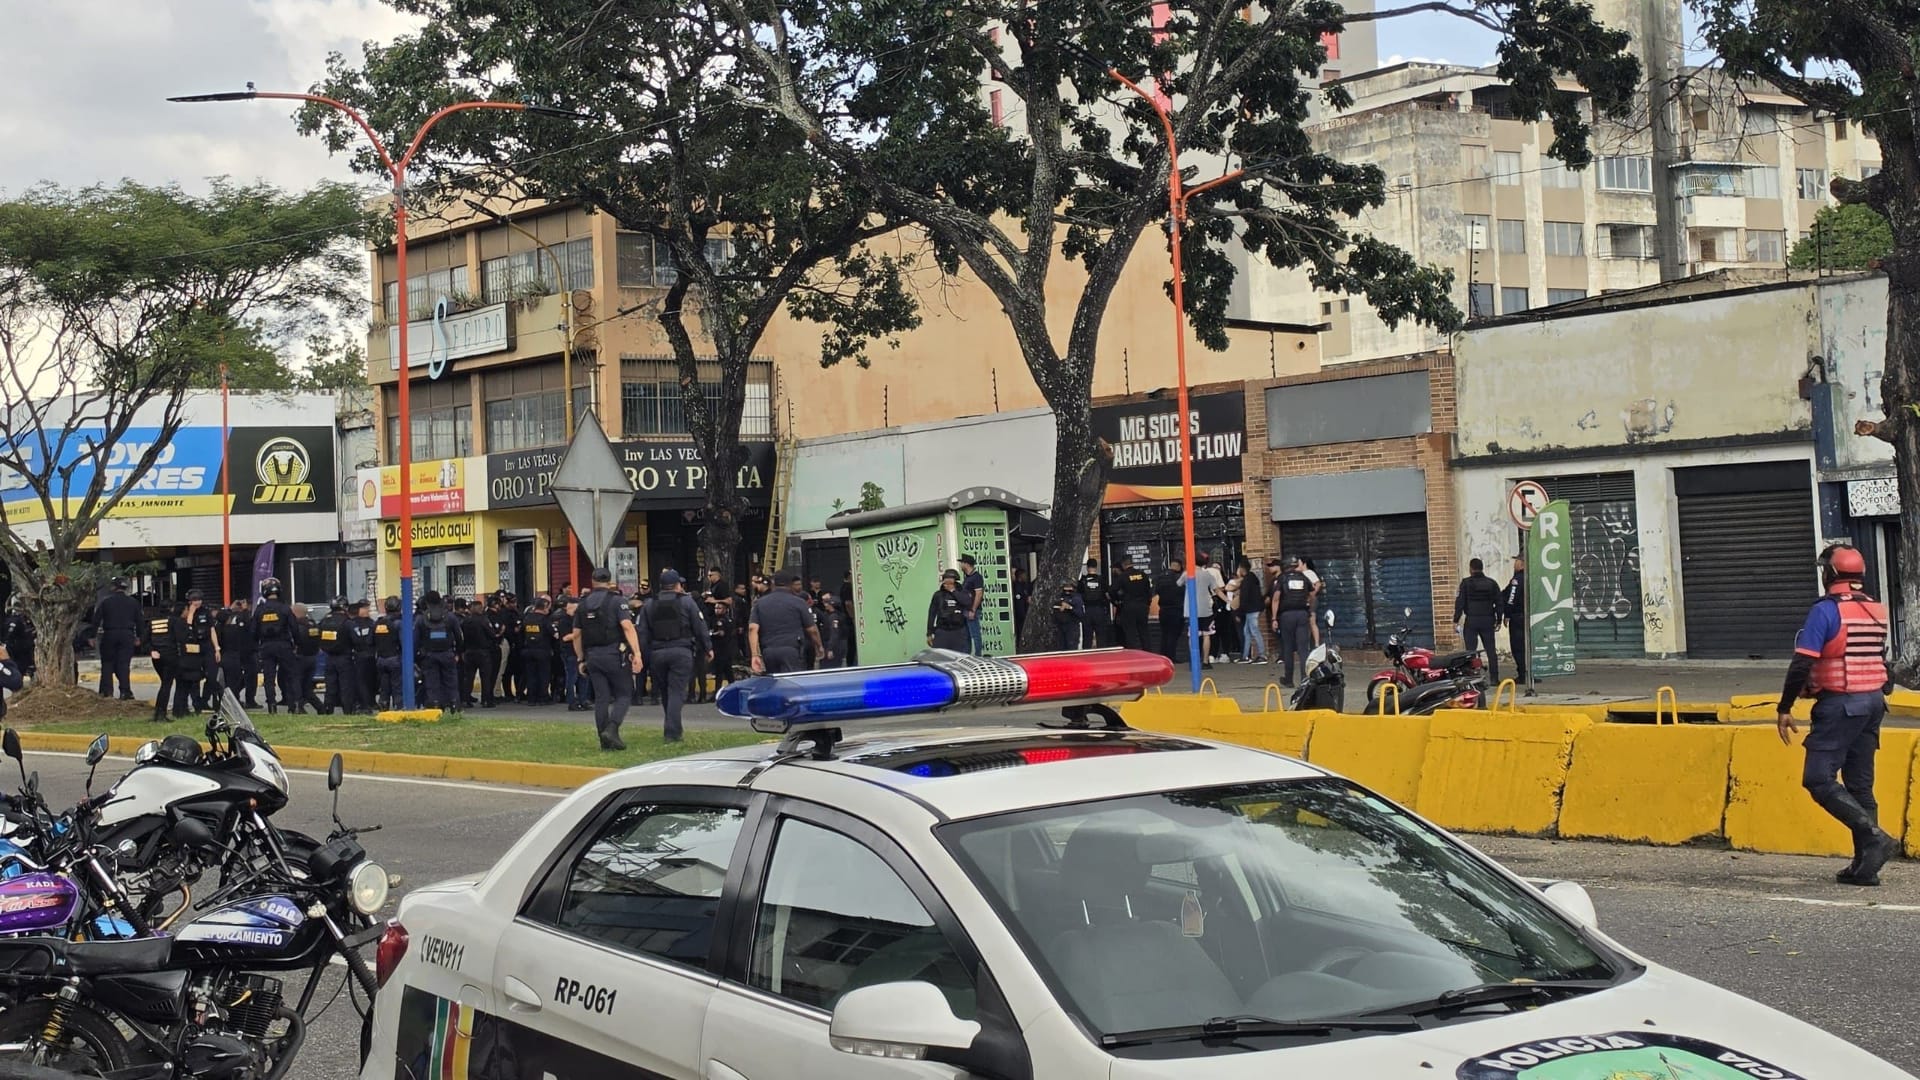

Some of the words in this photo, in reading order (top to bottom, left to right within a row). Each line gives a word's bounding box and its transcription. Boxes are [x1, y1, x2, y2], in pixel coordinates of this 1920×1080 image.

[1120, 416, 1145, 442] MG
[1150, 411, 1200, 439] SOCS
[518, 456, 531, 470] LAS
[533, 453, 556, 468] VEGAS
[625, 449, 643, 461] Inv
[650, 448, 672, 461] LAS
[1110, 440, 1163, 468] ARADA
[1197, 432, 1242, 460] FLOW
[492, 475, 524, 501] ORO
[527, 476, 535, 494] Y
[624, 466, 660, 491] RO
[666, 470, 678, 487] Y
[686, 465, 763, 490] PTA
[396, 520, 445, 541] Cshéalo
[447, 517, 472, 542] aquí
[877, 535, 918, 560] QUESO
[554, 976, 617, 1015] RP-061
